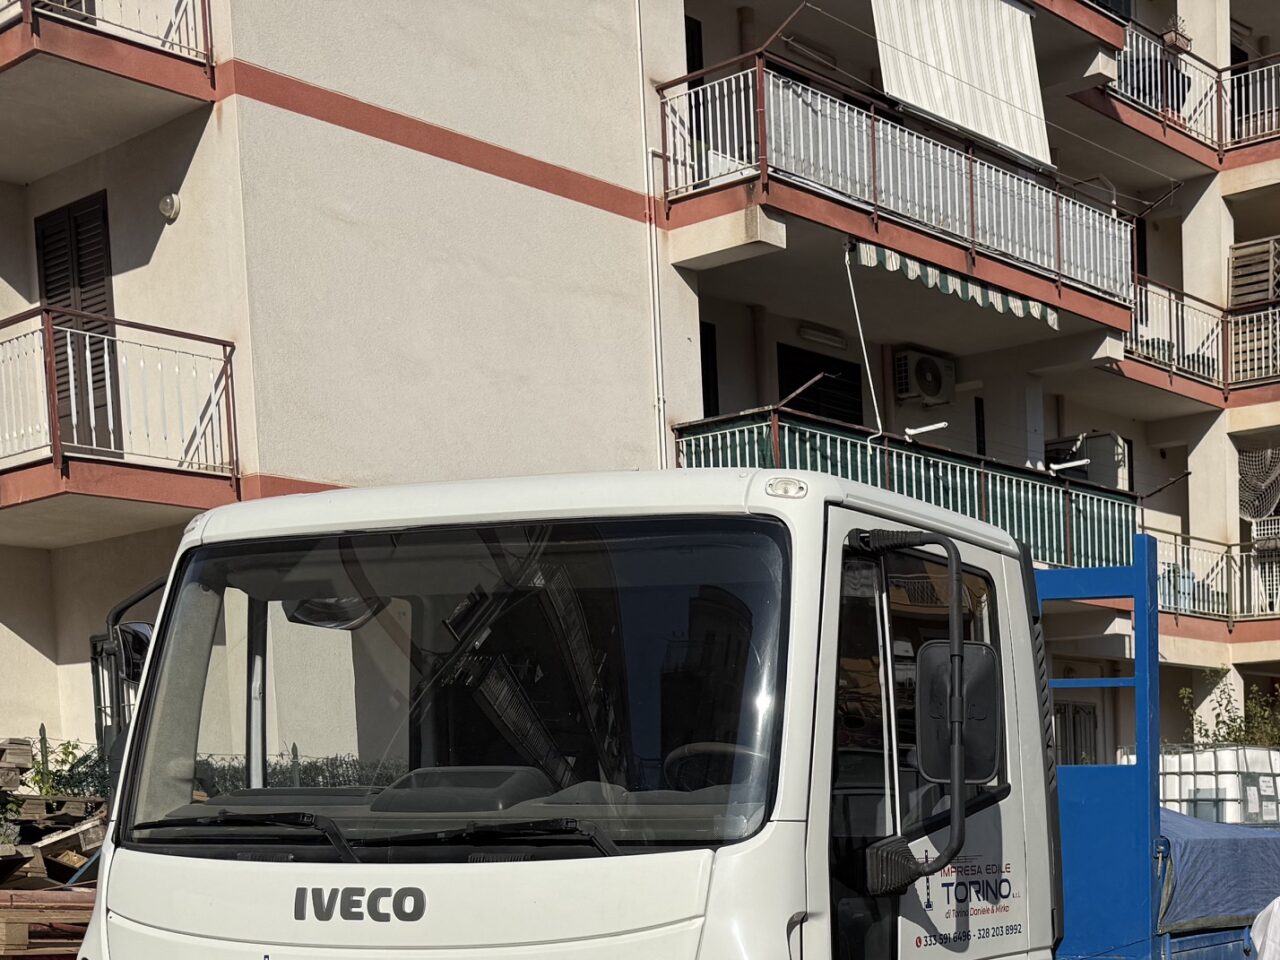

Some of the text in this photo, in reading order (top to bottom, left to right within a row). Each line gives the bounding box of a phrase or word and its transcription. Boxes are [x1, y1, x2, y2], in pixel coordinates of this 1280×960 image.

[940, 862, 1011, 878] IMPRESA EDILE
[293, 886, 427, 923] IVECO
[941, 878, 1012, 905] TORINO
[923, 935, 937, 948] 333
[938, 932, 951, 945] 591
[977, 928, 990, 940] 328
[991, 926, 1004, 937] 203
[1005, 923, 1022, 935] 8992
